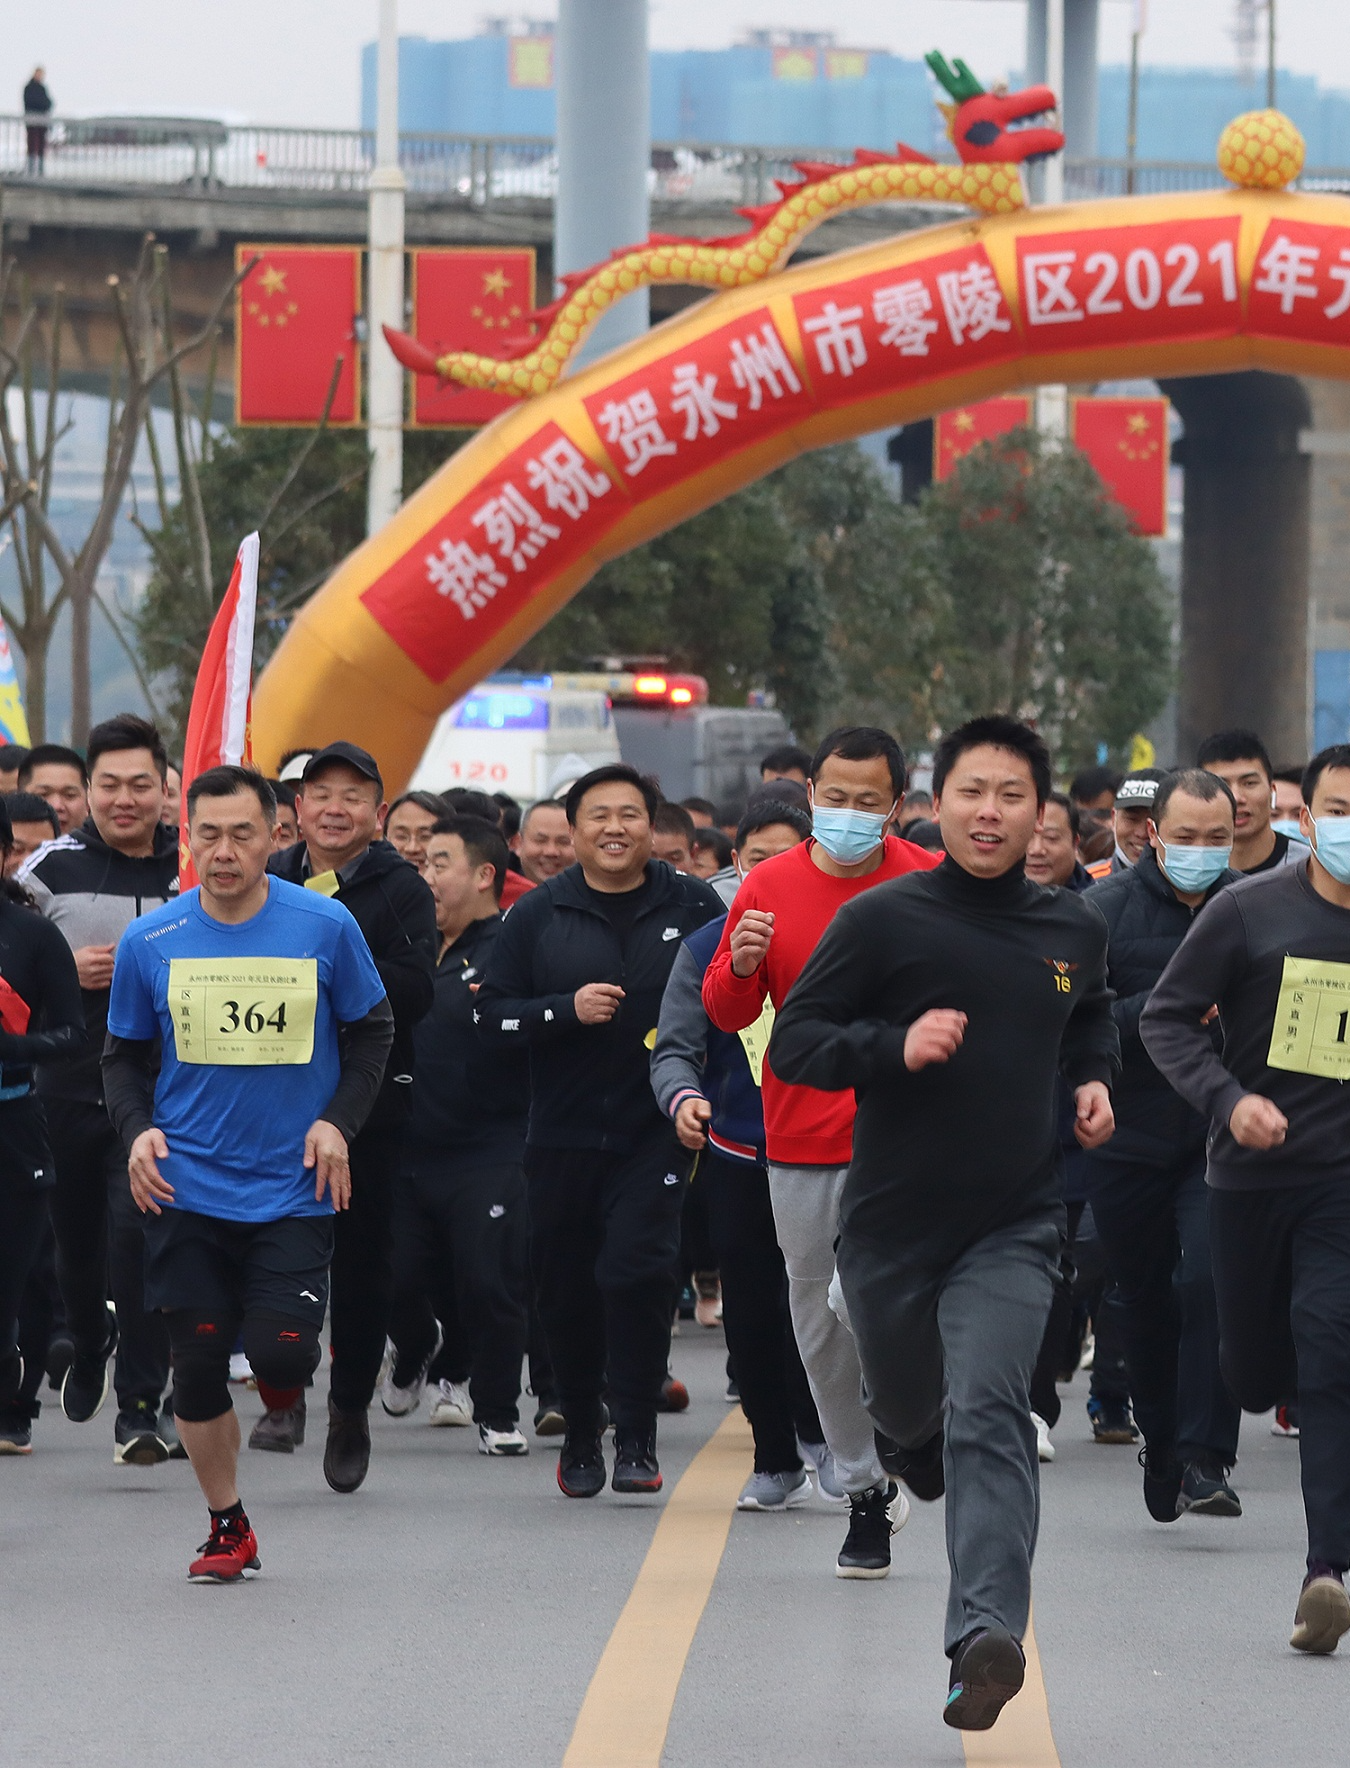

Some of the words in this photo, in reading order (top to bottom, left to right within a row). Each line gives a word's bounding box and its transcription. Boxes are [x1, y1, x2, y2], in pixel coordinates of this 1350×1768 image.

[449, 761, 508, 783] 120
[1120, 783, 1157, 798] adid
[219, 1000, 287, 1034] 364
[501, 1018, 521, 1031] NIKE
